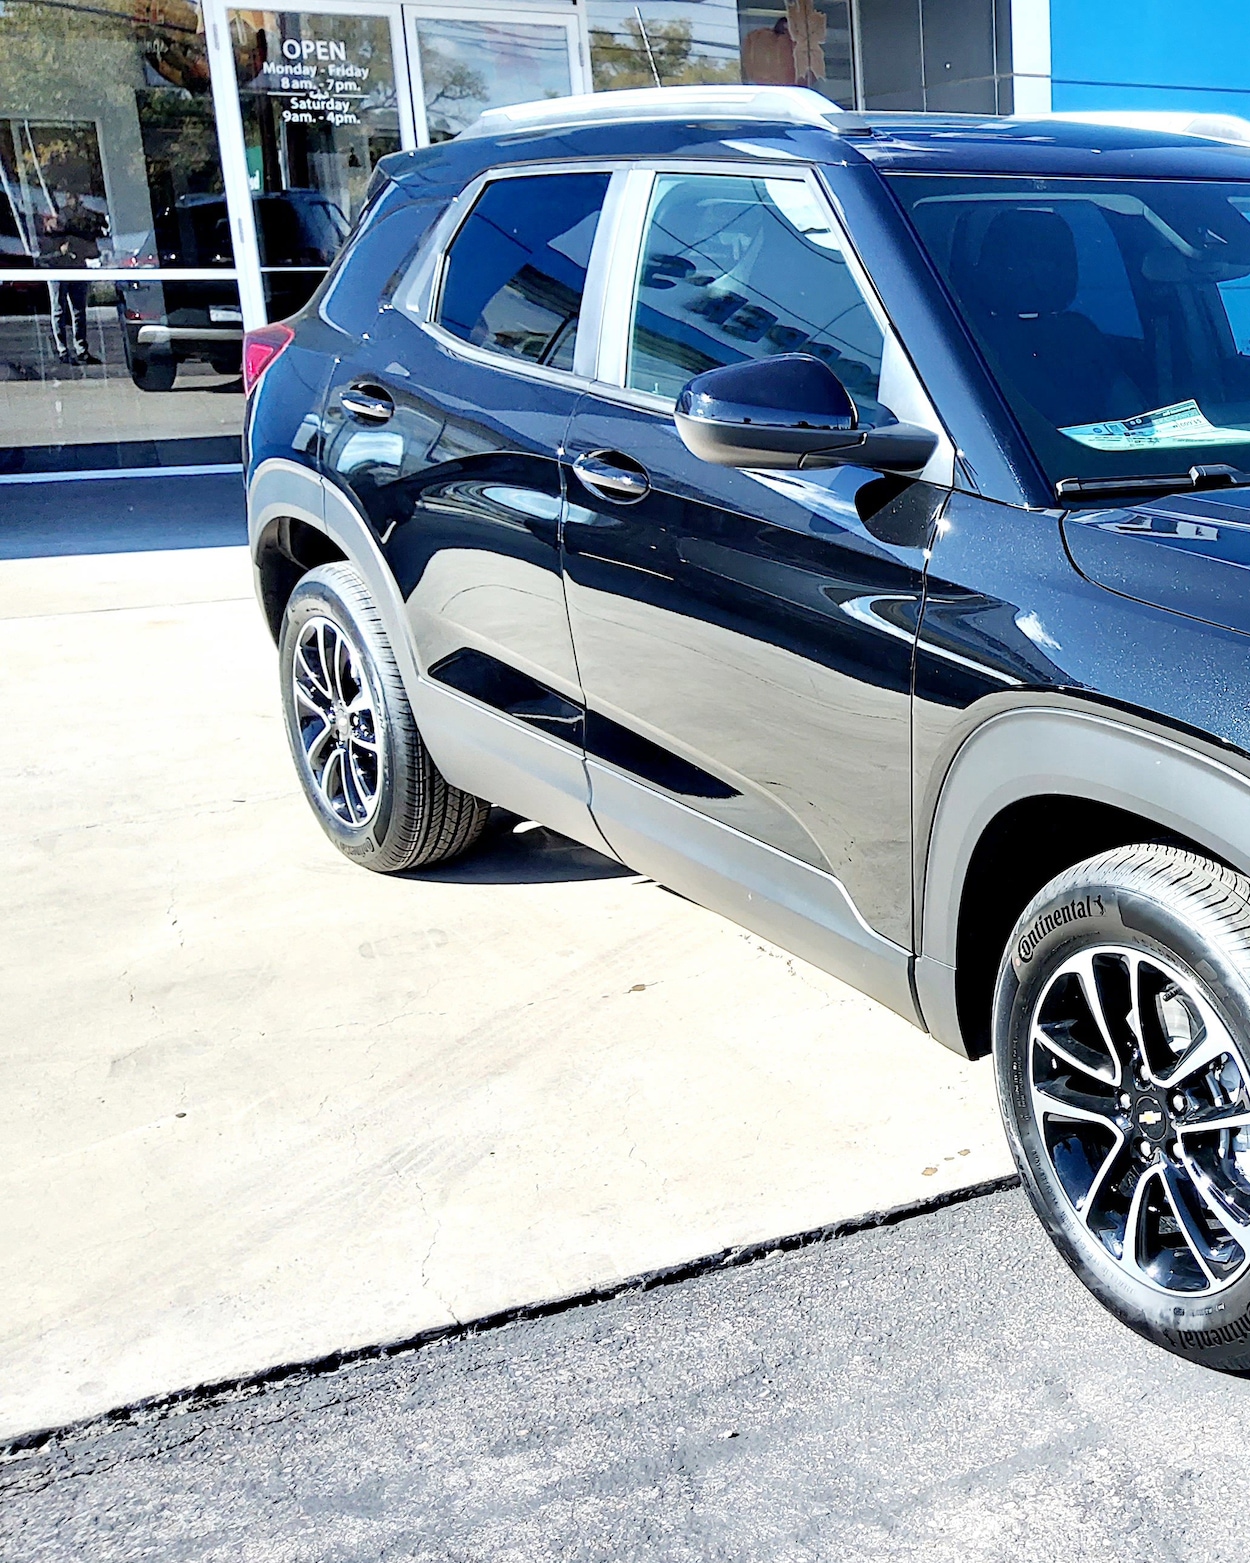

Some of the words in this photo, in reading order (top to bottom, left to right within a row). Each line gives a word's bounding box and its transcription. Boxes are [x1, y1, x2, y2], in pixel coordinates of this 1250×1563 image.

[282, 39, 347, 61] OPEN
[262, 61, 317, 78] Monday
[327, 63, 369, 80] Friday
[289, 96, 350, 113] Saturday
[282, 109, 317, 123] 9am.
[326, 111, 361, 127] 4pm.
[1018, 895, 1093, 964] Continental
